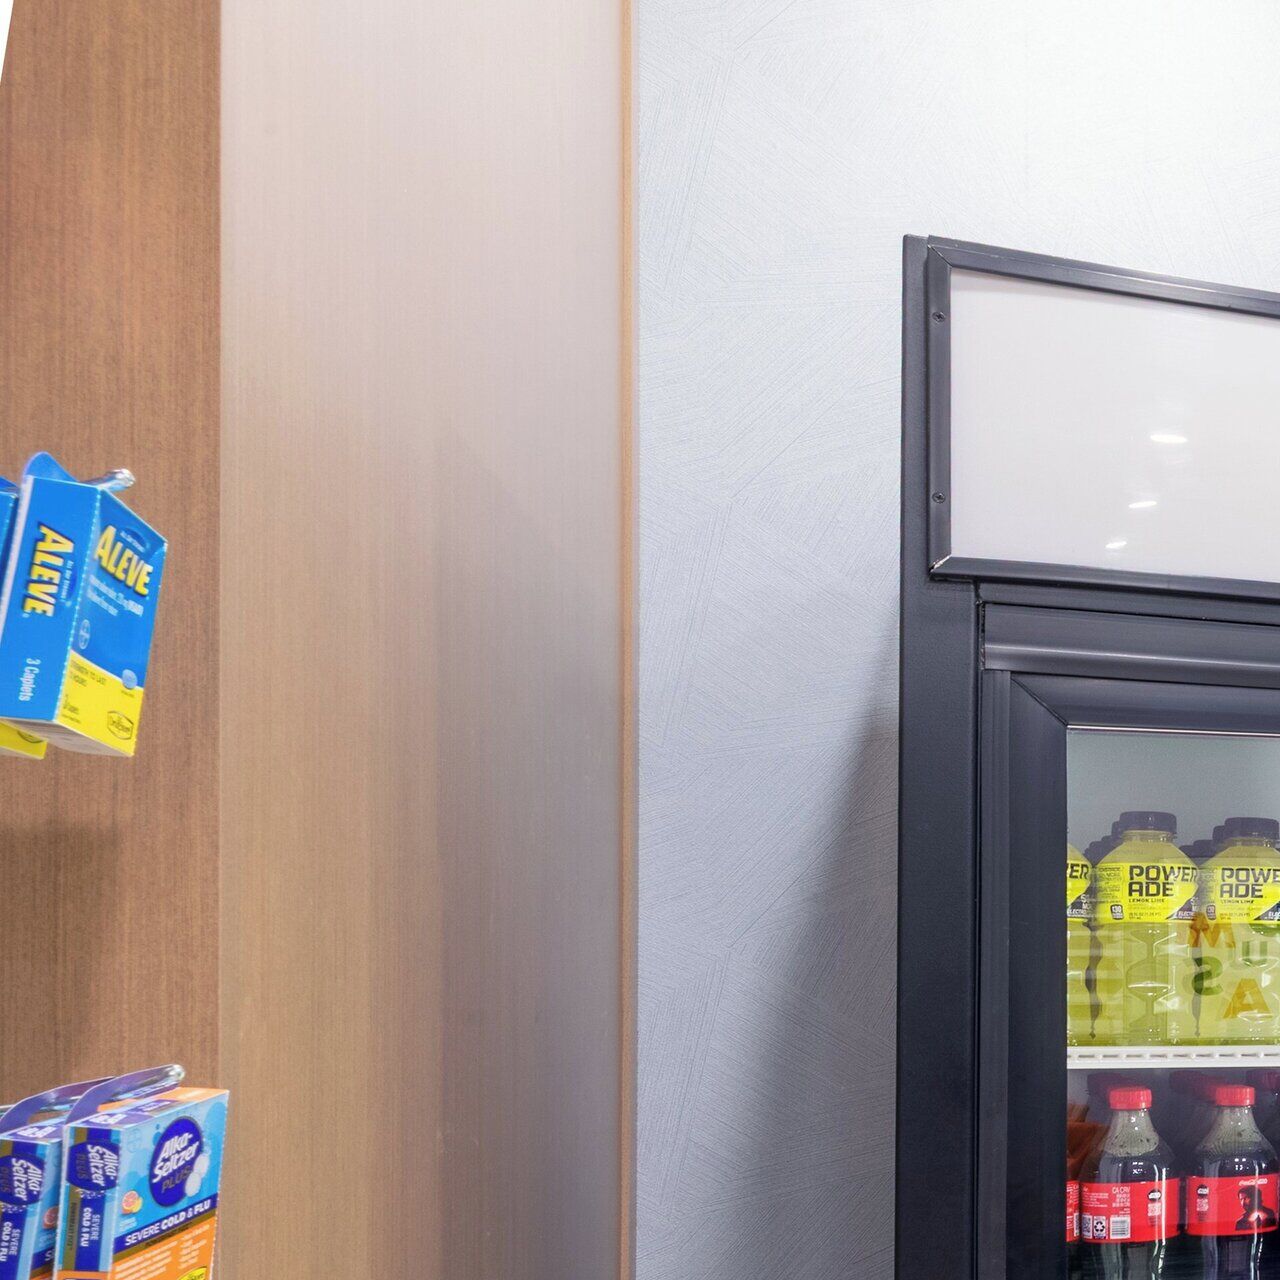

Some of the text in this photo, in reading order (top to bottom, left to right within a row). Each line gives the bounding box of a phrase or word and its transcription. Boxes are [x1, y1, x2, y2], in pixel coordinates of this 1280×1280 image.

[23, 525, 74, 617] ALEVE
[94, 525, 153, 596] ALEVE
[18, 666, 39, 702] Caplets
[1128, 882, 1174, 897] ADE
[1220, 883, 1263, 898] ADE
[87, 1145, 104, 1187] Seltzer
[152, 1141, 200, 1183] Seltzer
[157, 1132, 193, 1163] Alka-
[12, 1158, 28, 1201] Seltzer
[82, 1207, 92, 1228] COLD
[90, 1213, 100, 1241] SEVERE
[125, 1222, 160, 1246] SEVERE
[161, 1211, 186, 1230] COLD
[194, 1199, 211, 1216] FLU
